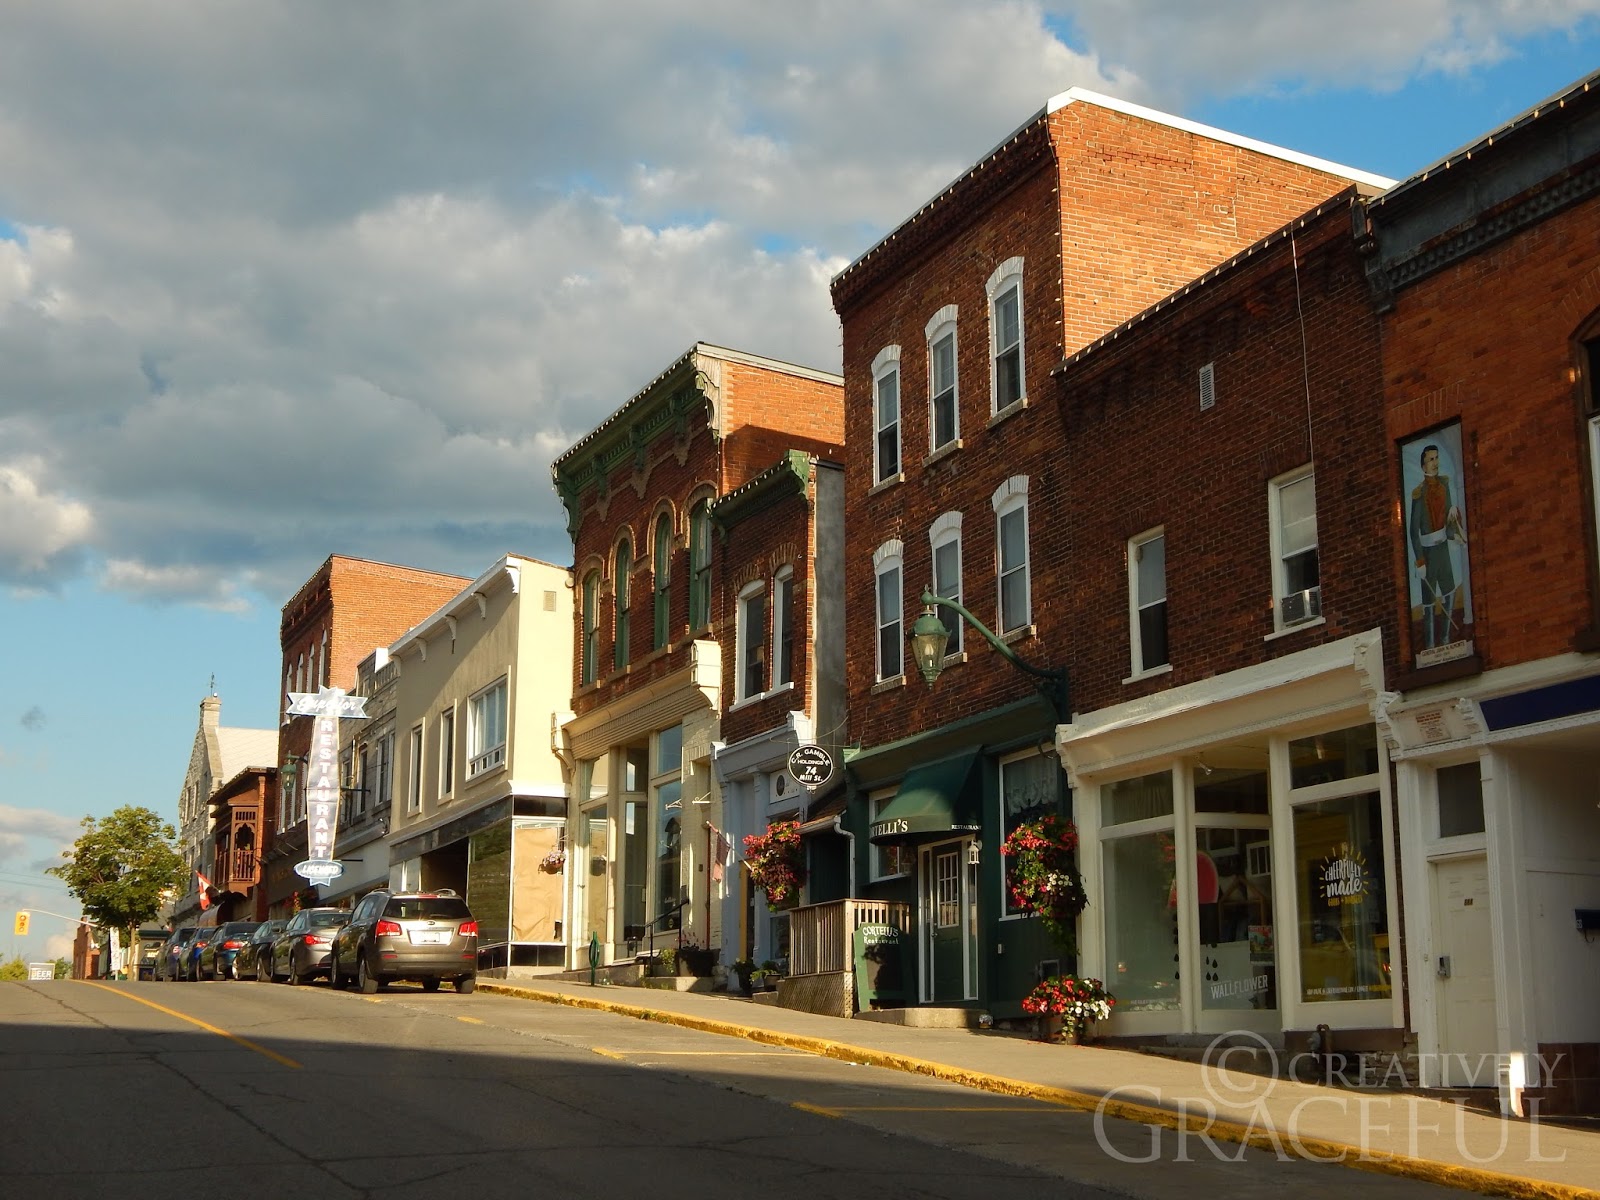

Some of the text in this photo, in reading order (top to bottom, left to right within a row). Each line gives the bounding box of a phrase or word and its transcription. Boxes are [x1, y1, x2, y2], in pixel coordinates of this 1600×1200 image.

[804, 749, 831, 766] GAMBLE
[805, 766, 817, 775] 74
[315, 720, 333, 858] RESTAURANT
[1325, 860, 1361, 881] CHEERFULLY
[1326, 872, 1363, 897] made
[32, 970, 52, 978] BEER
[1211, 974, 1269, 1000] WALLFLOWER
